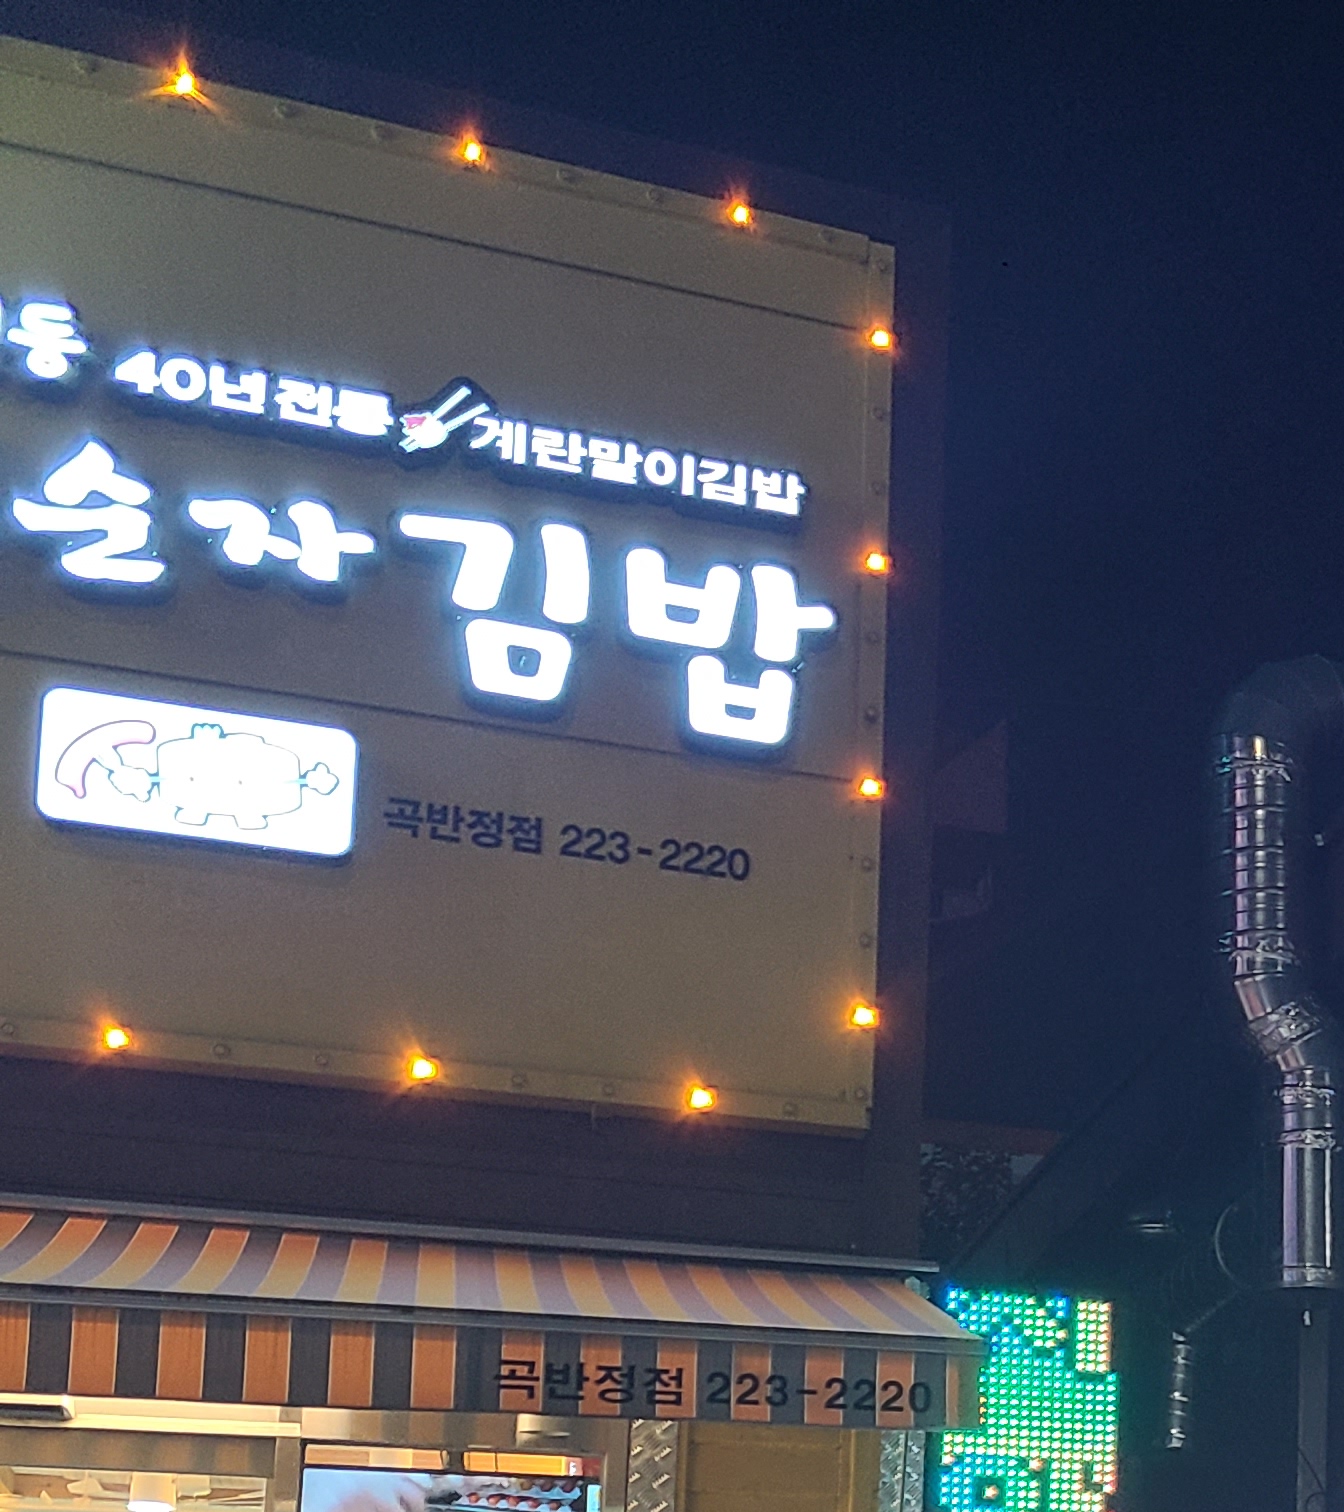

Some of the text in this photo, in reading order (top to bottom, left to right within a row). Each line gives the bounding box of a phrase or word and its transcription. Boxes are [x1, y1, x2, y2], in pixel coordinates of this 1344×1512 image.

[468, 414, 808, 516] 계란말이김밥
[382, 796, 752, 883] 곡반정점 223-2220
[494, 1358, 933, 1416] 곡반정점 223-2220
